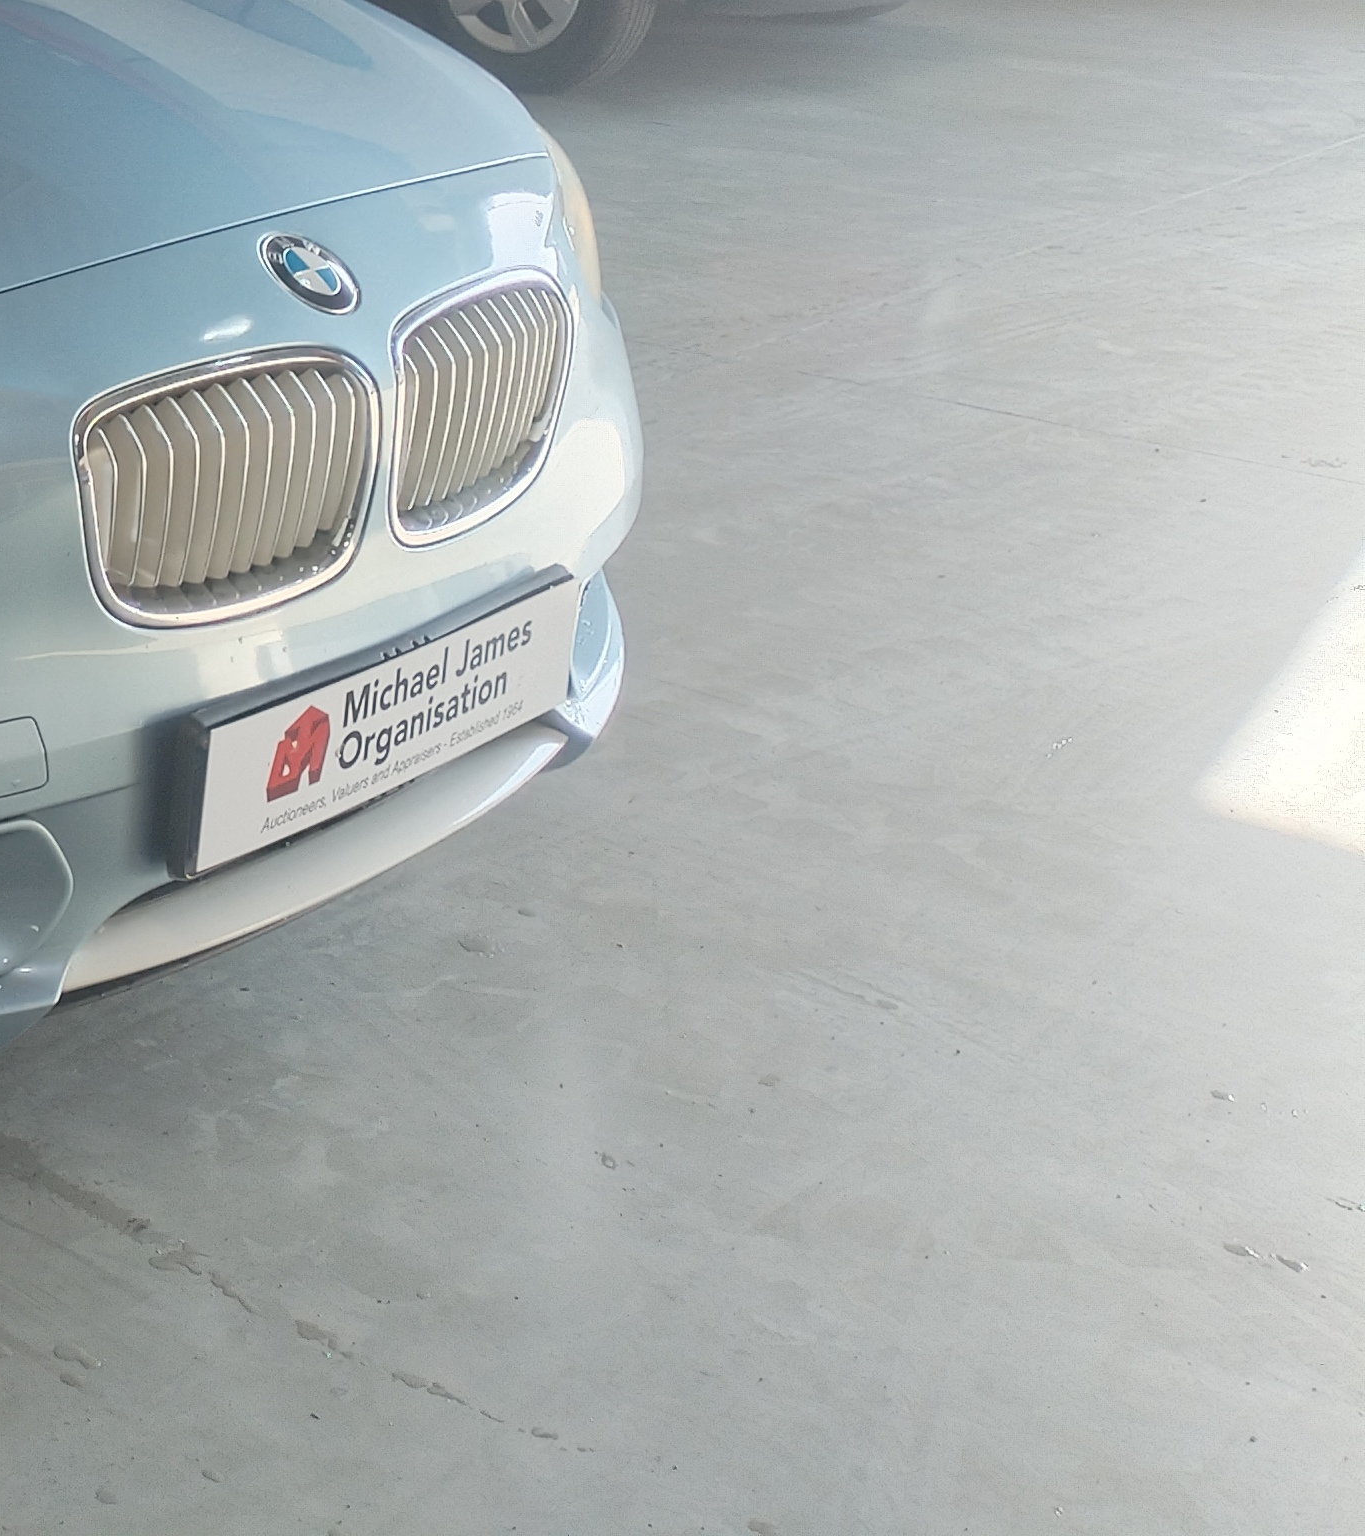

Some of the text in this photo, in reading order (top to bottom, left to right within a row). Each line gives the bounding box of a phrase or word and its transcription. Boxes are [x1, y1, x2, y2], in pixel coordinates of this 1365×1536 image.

[338, 671, 508, 769] Organisation
[342, 619, 533, 727] Michael James
[260, 795, 327, 834] Auctioneers,
[331, 777, 369, 804] Valuers
[371, 765, 390, 785] and
[391, 743, 442, 777] Appraisers
[449, 712, 500, 748] Established
